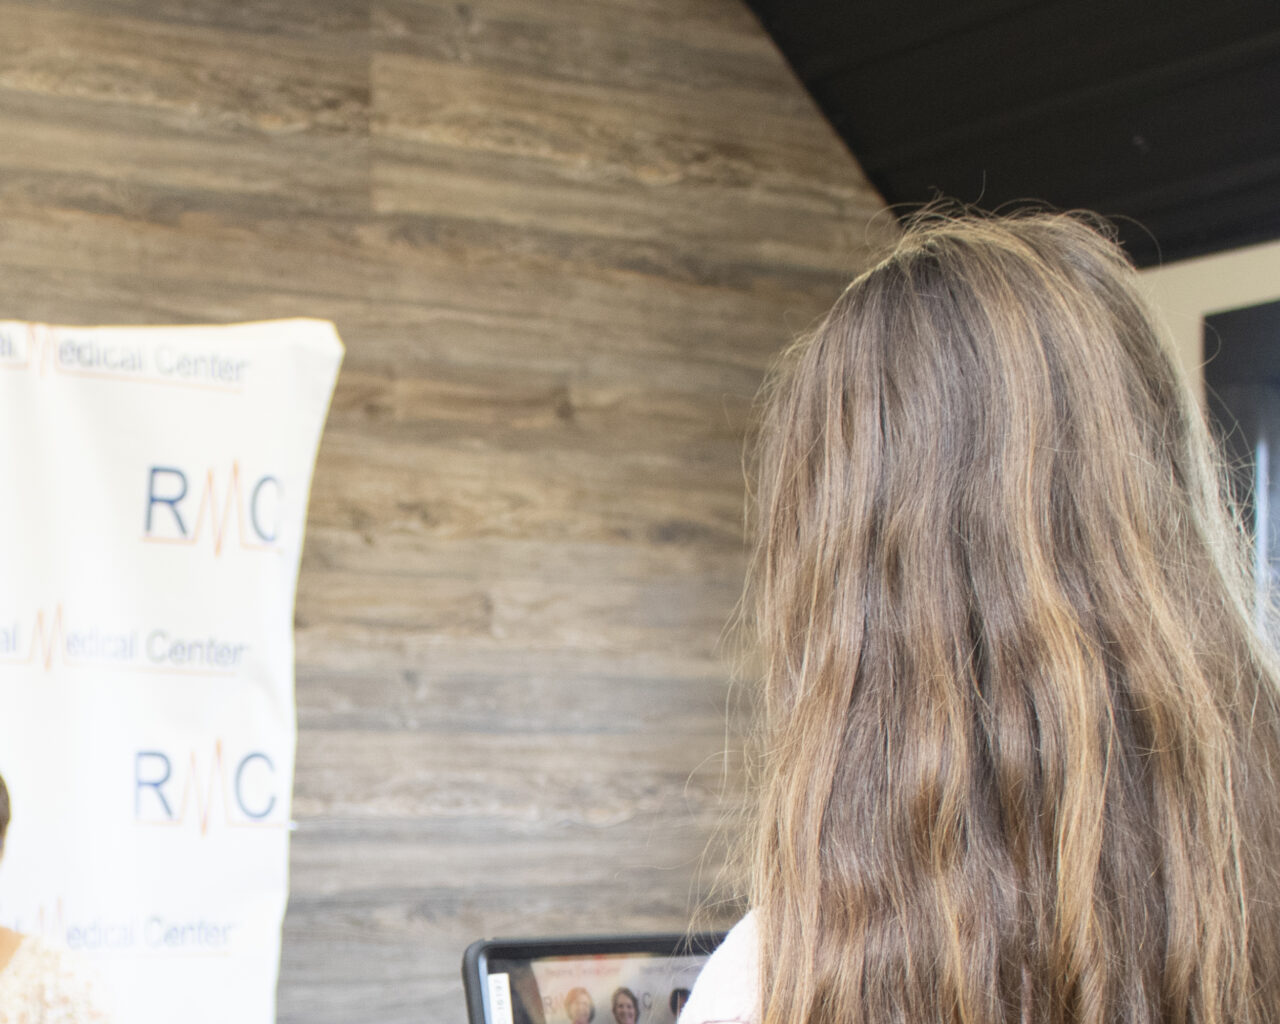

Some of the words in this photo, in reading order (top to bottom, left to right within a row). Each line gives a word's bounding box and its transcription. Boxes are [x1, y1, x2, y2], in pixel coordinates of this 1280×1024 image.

[155, 345, 249, 384] Center
[147, 630, 249, 667] Center
[144, 916, 235, 950] Center
